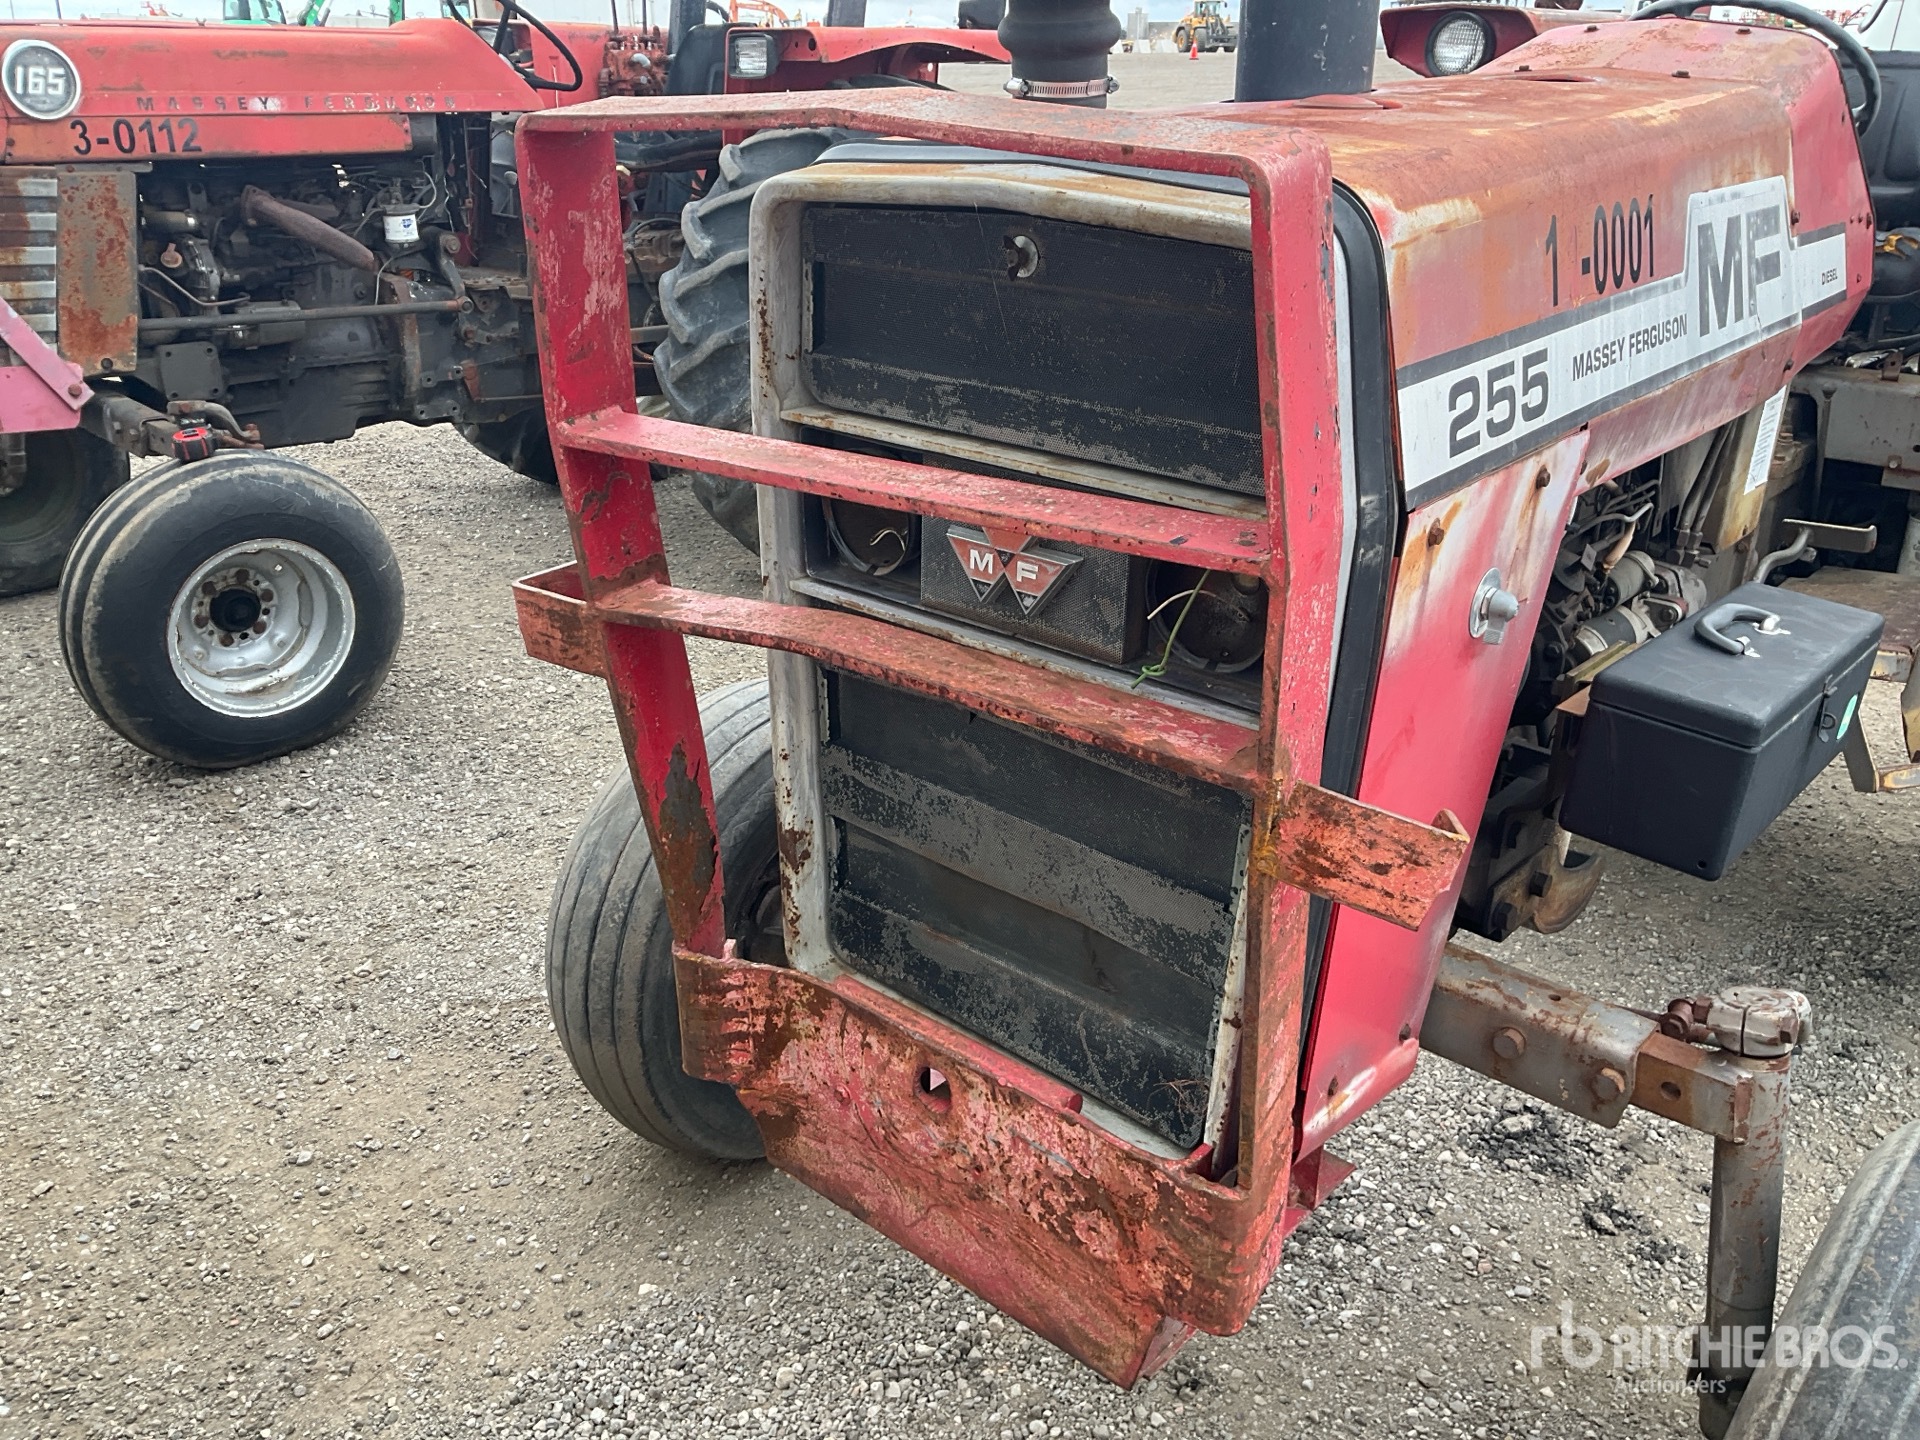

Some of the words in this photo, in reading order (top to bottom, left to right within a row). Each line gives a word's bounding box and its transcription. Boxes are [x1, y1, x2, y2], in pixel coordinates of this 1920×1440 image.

[15, 66, 66, 95] 165
[136, 96, 269, 111] MASSEY
[70, 118, 202, 155] 3-0112
[1698, 205, 1781, 338] MF
[1821, 268, 1838, 286] DIESEL
[1448, 347, 1549, 459] 255
[1572, 336, 1626, 382] MASSEY
[1628, 313, 1688, 358] FERGUSON
